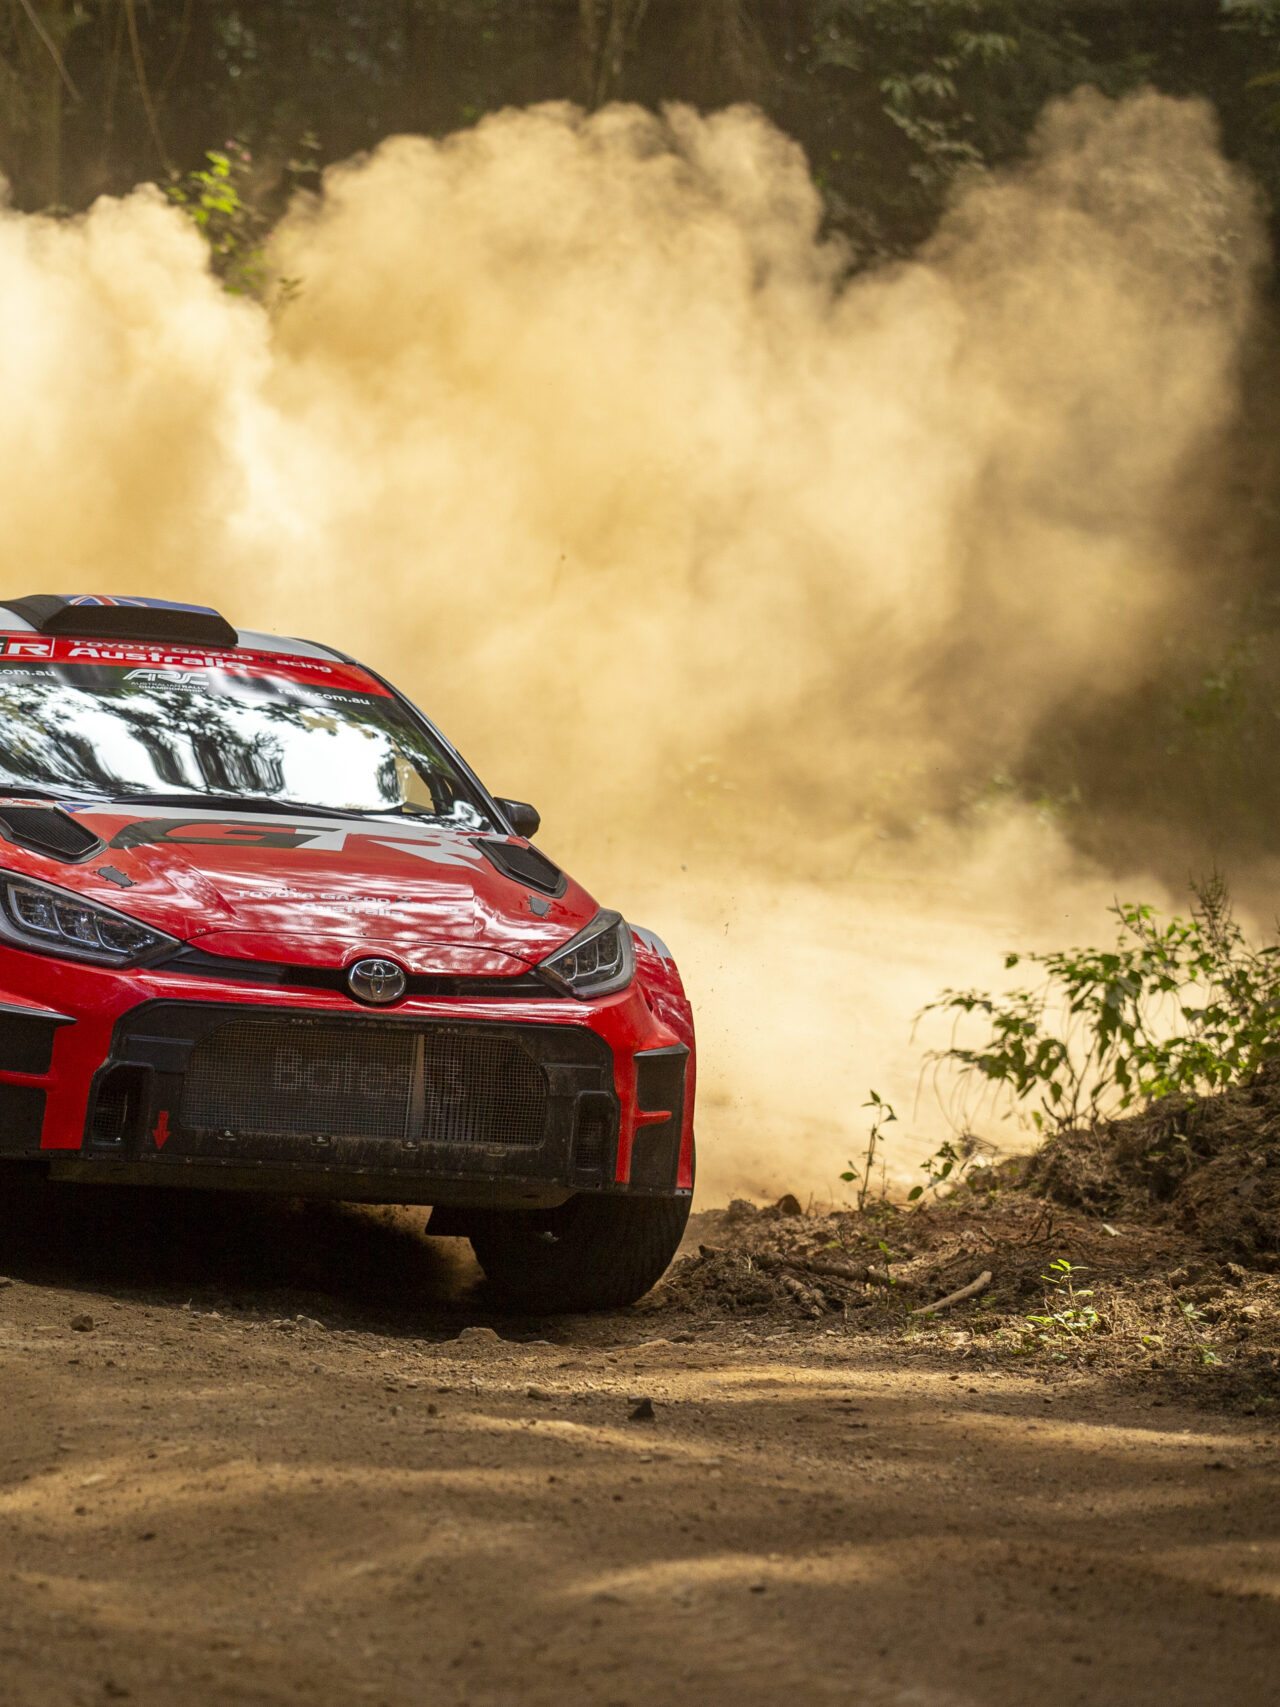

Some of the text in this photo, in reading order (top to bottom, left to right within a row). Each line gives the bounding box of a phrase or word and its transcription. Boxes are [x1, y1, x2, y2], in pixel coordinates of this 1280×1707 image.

[68, 639, 165, 652] TOYOTA
[171, 646, 254, 661] GAZOO
[68, 647, 248, 671] Australia
[278, 688, 371, 705] rally.com.au
[235, 889, 391, 904] TOYOTA GAZOO
[299, 902, 406, 918] Australia
